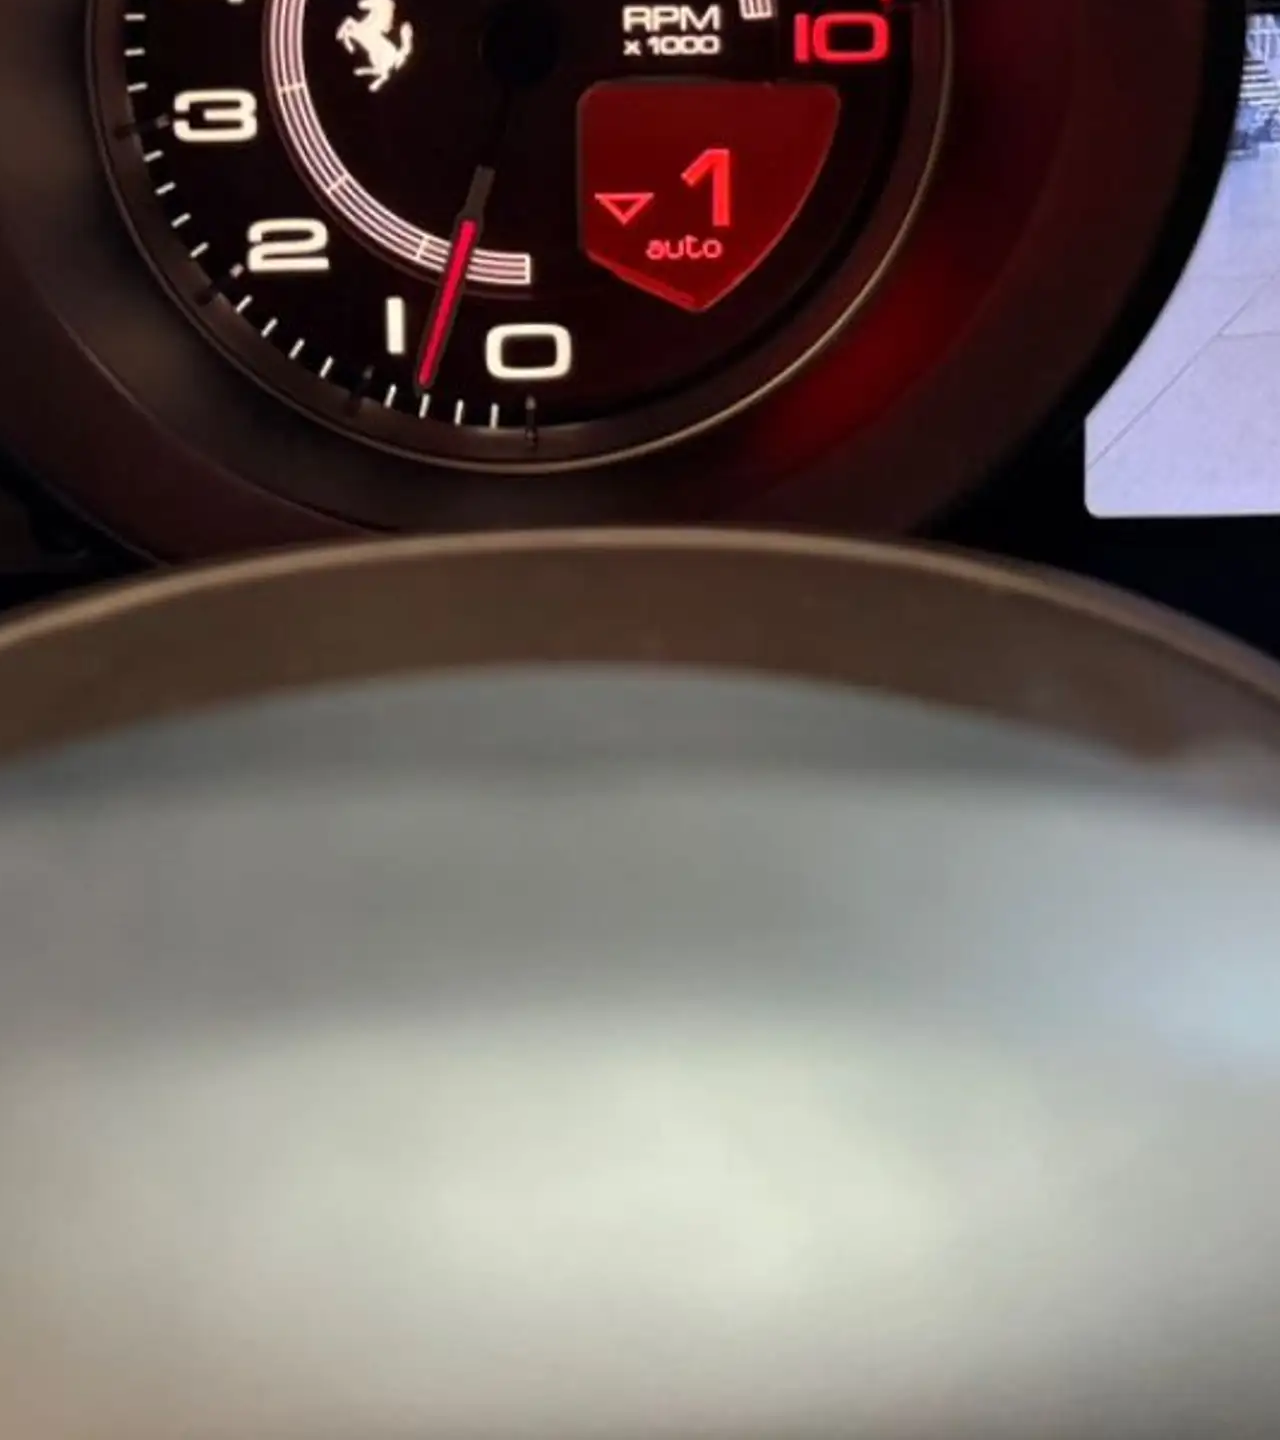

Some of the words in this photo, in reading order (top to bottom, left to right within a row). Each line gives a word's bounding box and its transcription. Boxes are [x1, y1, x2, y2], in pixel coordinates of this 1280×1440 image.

[623, 5, 720, 32] RPM
[795, 13, 888, 62] 10
[648, 35, 720, 55] 1000
[174, 90, 257, 141] 3
[683, 149, 729, 225] 1
[248, 219, 329, 271] 2
[647, 236, 721, 259] auto
[387, 297, 404, 353] 1
[486, 324, 571, 379] 0
